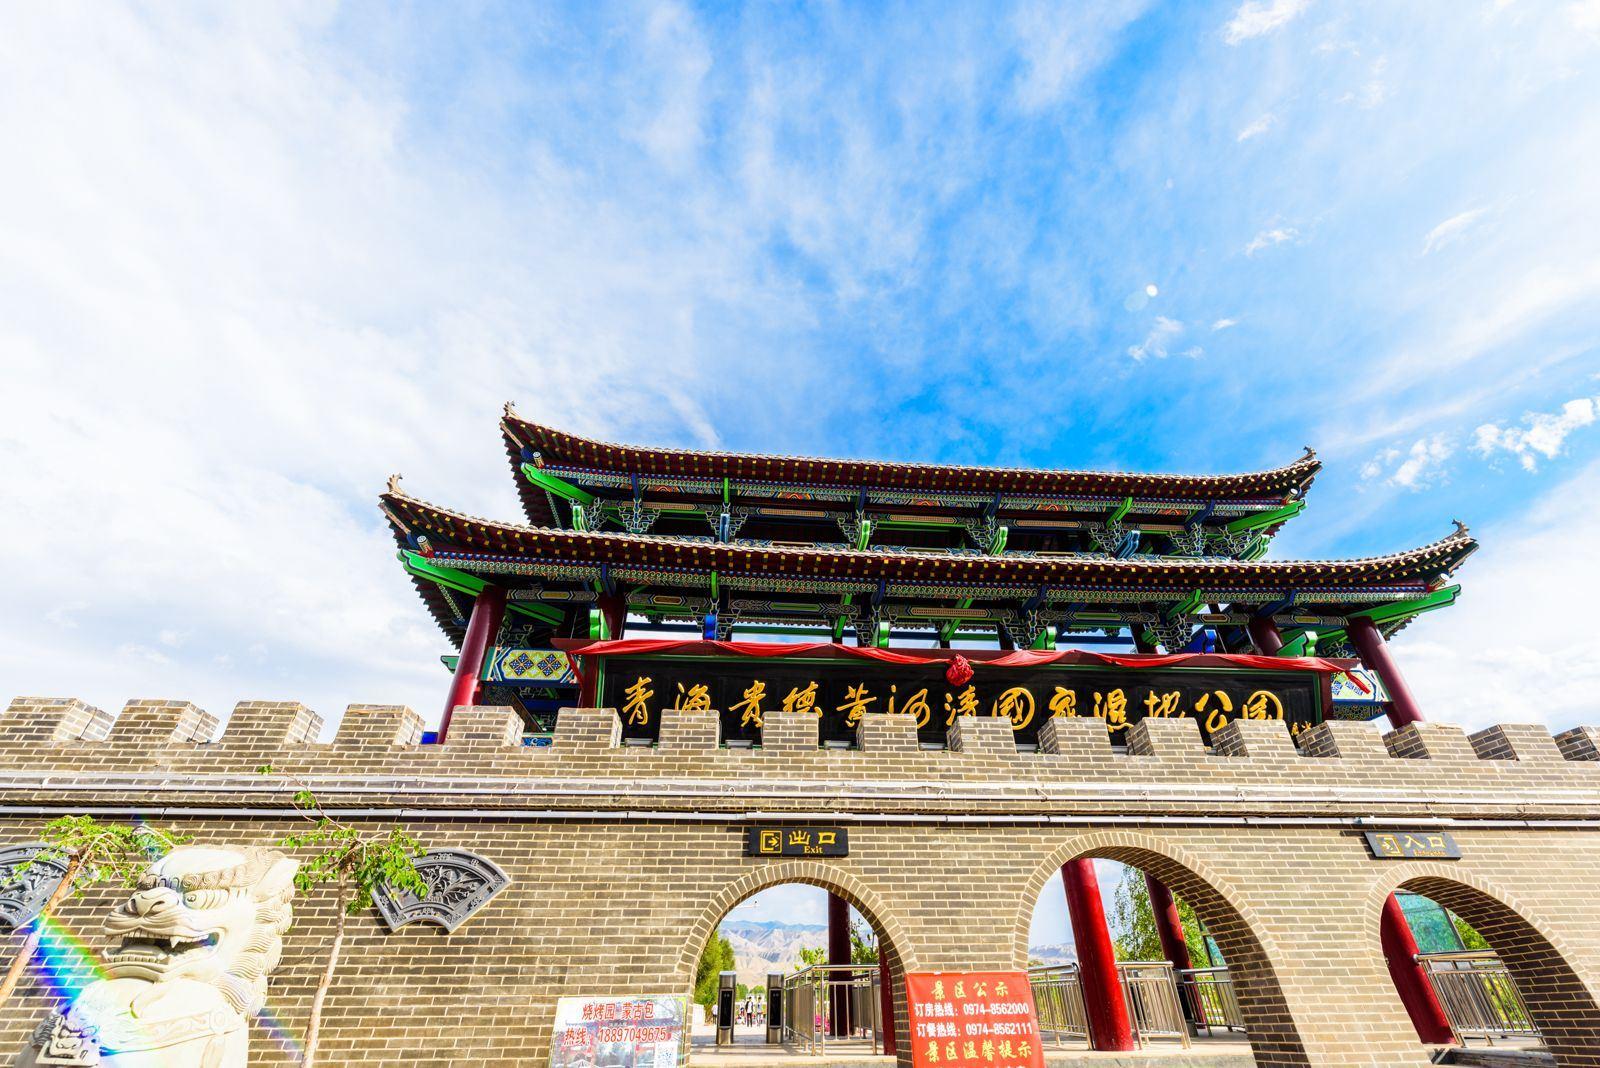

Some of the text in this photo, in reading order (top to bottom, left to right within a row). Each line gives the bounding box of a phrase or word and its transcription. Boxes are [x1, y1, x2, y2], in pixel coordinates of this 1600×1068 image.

[789, 830, 836, 845] 出口
[1404, 835, 1446, 848] 入口
[804, 846, 823, 854] Exit
[931, 980, 1009, 1000] 景区公示
[582, 1001, 654, 1020] 烧烤园 蒙古包
[925, 1040, 1032, 1063] 景区温馨提示
